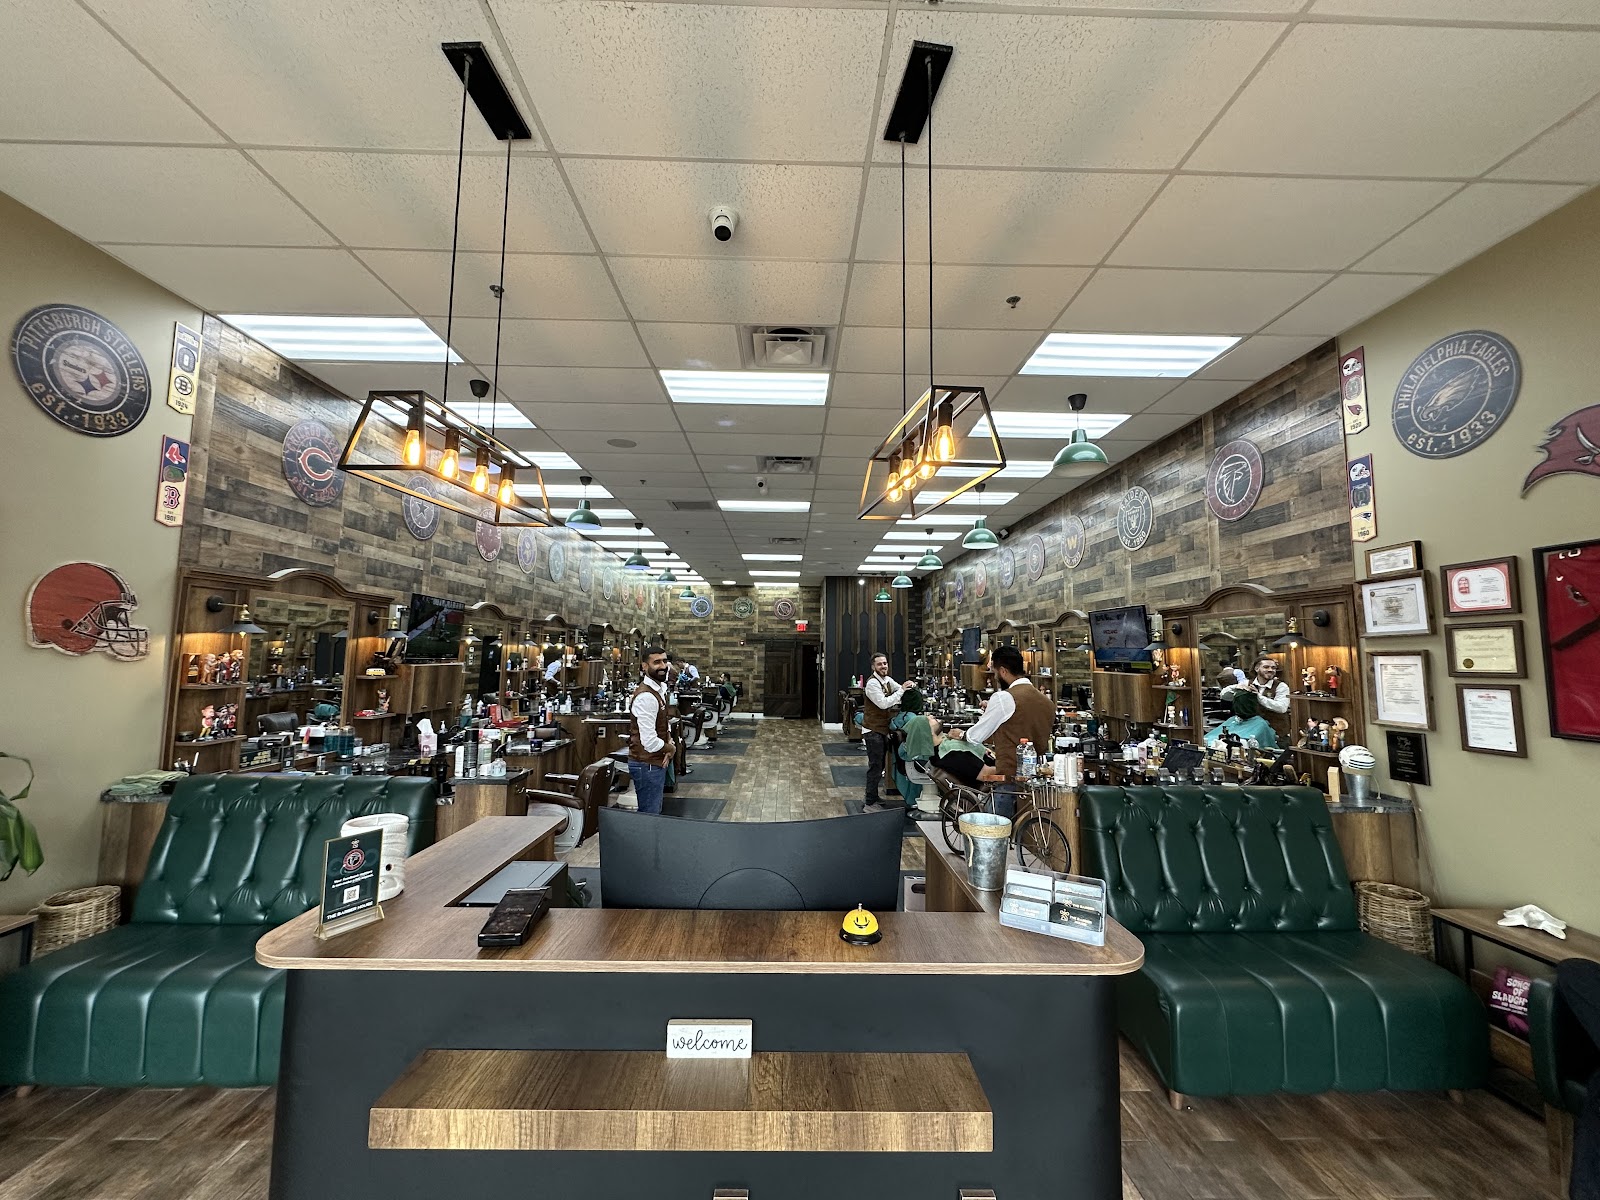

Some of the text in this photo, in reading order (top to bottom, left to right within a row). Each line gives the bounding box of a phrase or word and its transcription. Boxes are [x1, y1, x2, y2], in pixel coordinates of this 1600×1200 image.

[21, 313, 146, 393] PITTSBURGH STEELERS
[62, 359, 87, 374] Steelers
[1397, 339, 1510, 409] PHILADELPHIA EAGLES
[32, 383, 129, 431] est. 1933
[1406, 410, 1497, 452] est. 1933
[298, 447, 333, 481] C
[163, 485, 180, 509] B
[1120, 489, 1148, 511] RAIDERS
[1066, 533, 1078, 550] W
[1513, 988, 1524, 996] OF
[672, 1029, 748, 1051] welcome
